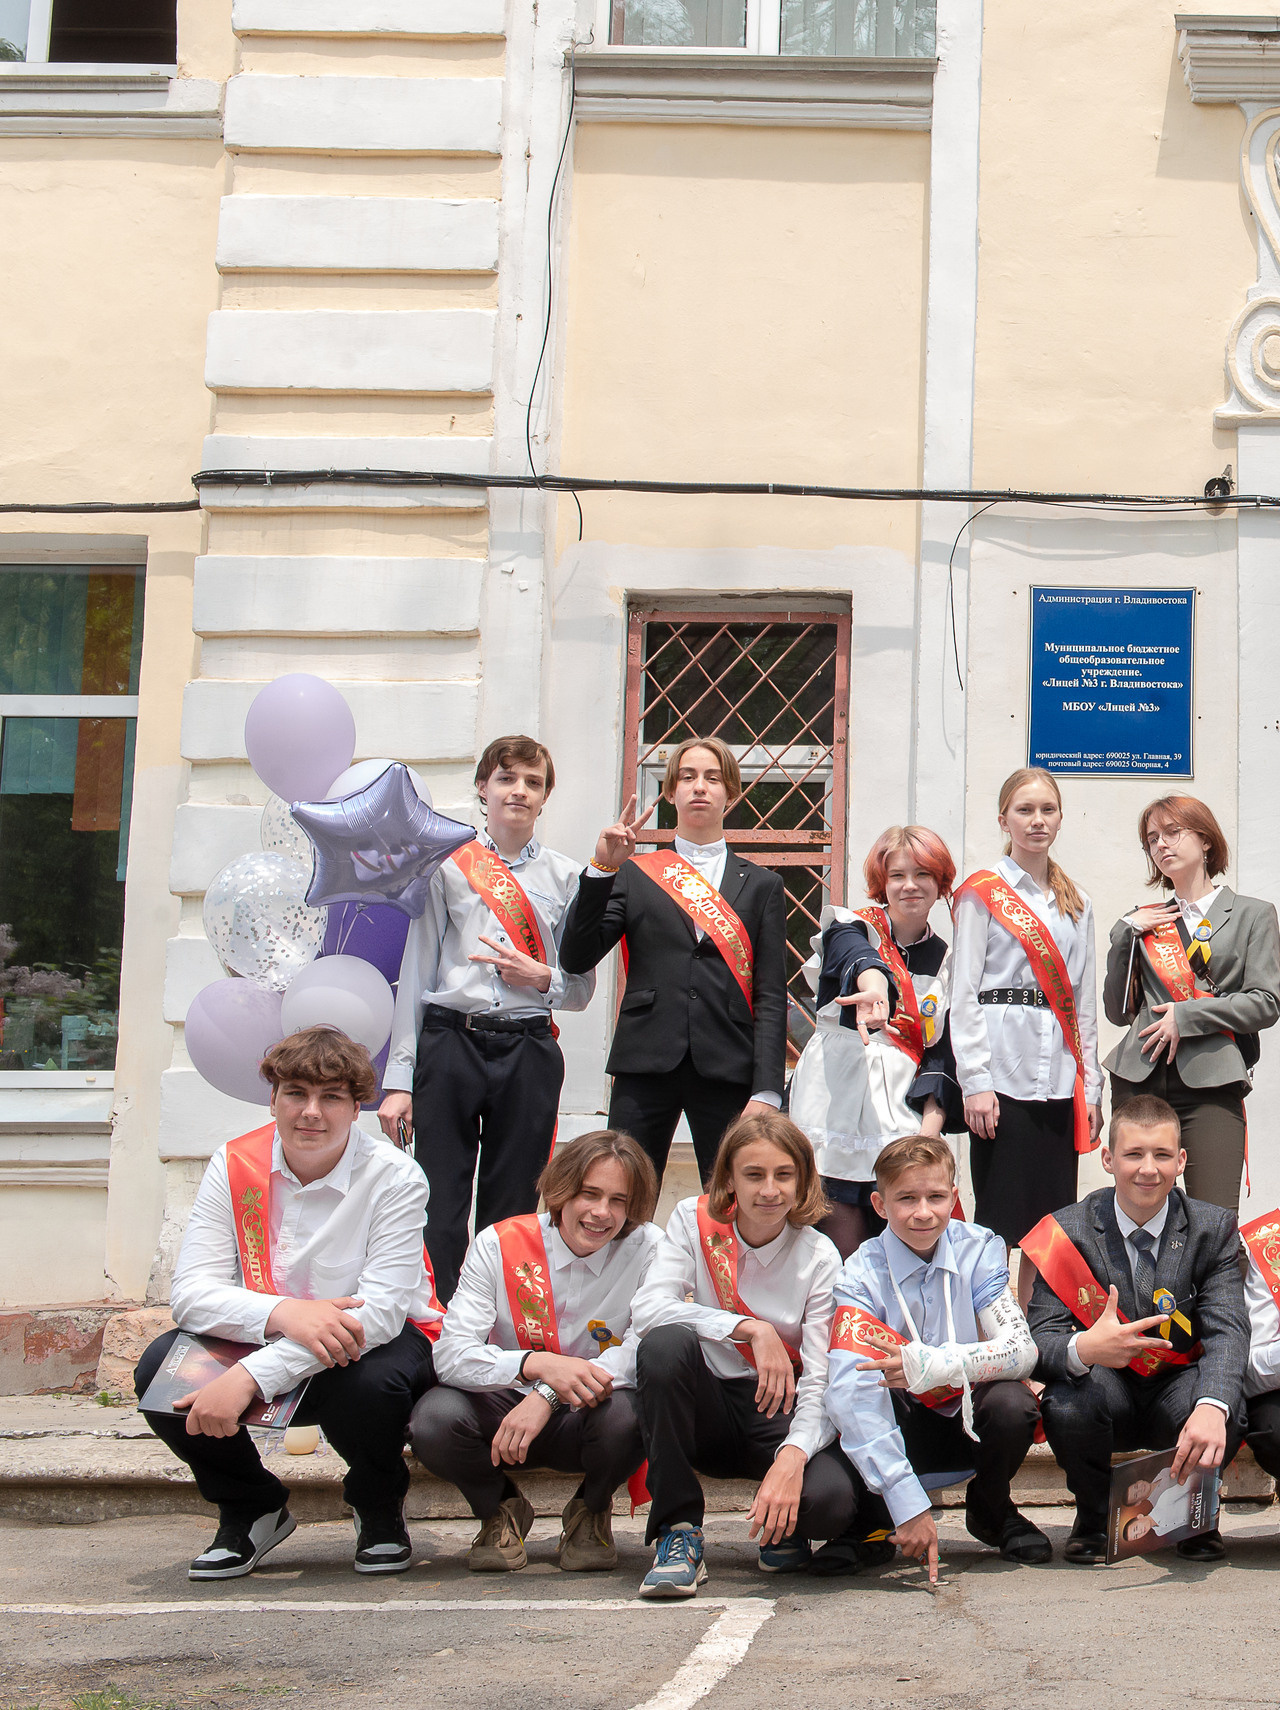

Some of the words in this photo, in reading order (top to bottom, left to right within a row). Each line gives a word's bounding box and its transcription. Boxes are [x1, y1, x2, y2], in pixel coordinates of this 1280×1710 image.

[1039, 594, 1112, 605] Администрация
[1123, 596, 1187, 605] Владивостока
[1045, 643, 1125, 654] Муниципальное
[1127, 644, 1180, 654] бюджетное
[1059, 656, 1165, 665] общеобразовательное
[1082, 679, 1098, 687] №3
[1110, 679, 1183, 689] Владивостока»
[1062, 702, 1096, 711] МБОУ
[1035, 752, 1081, 760] юридический
[1132, 761, 1163, 769] Опорная,
